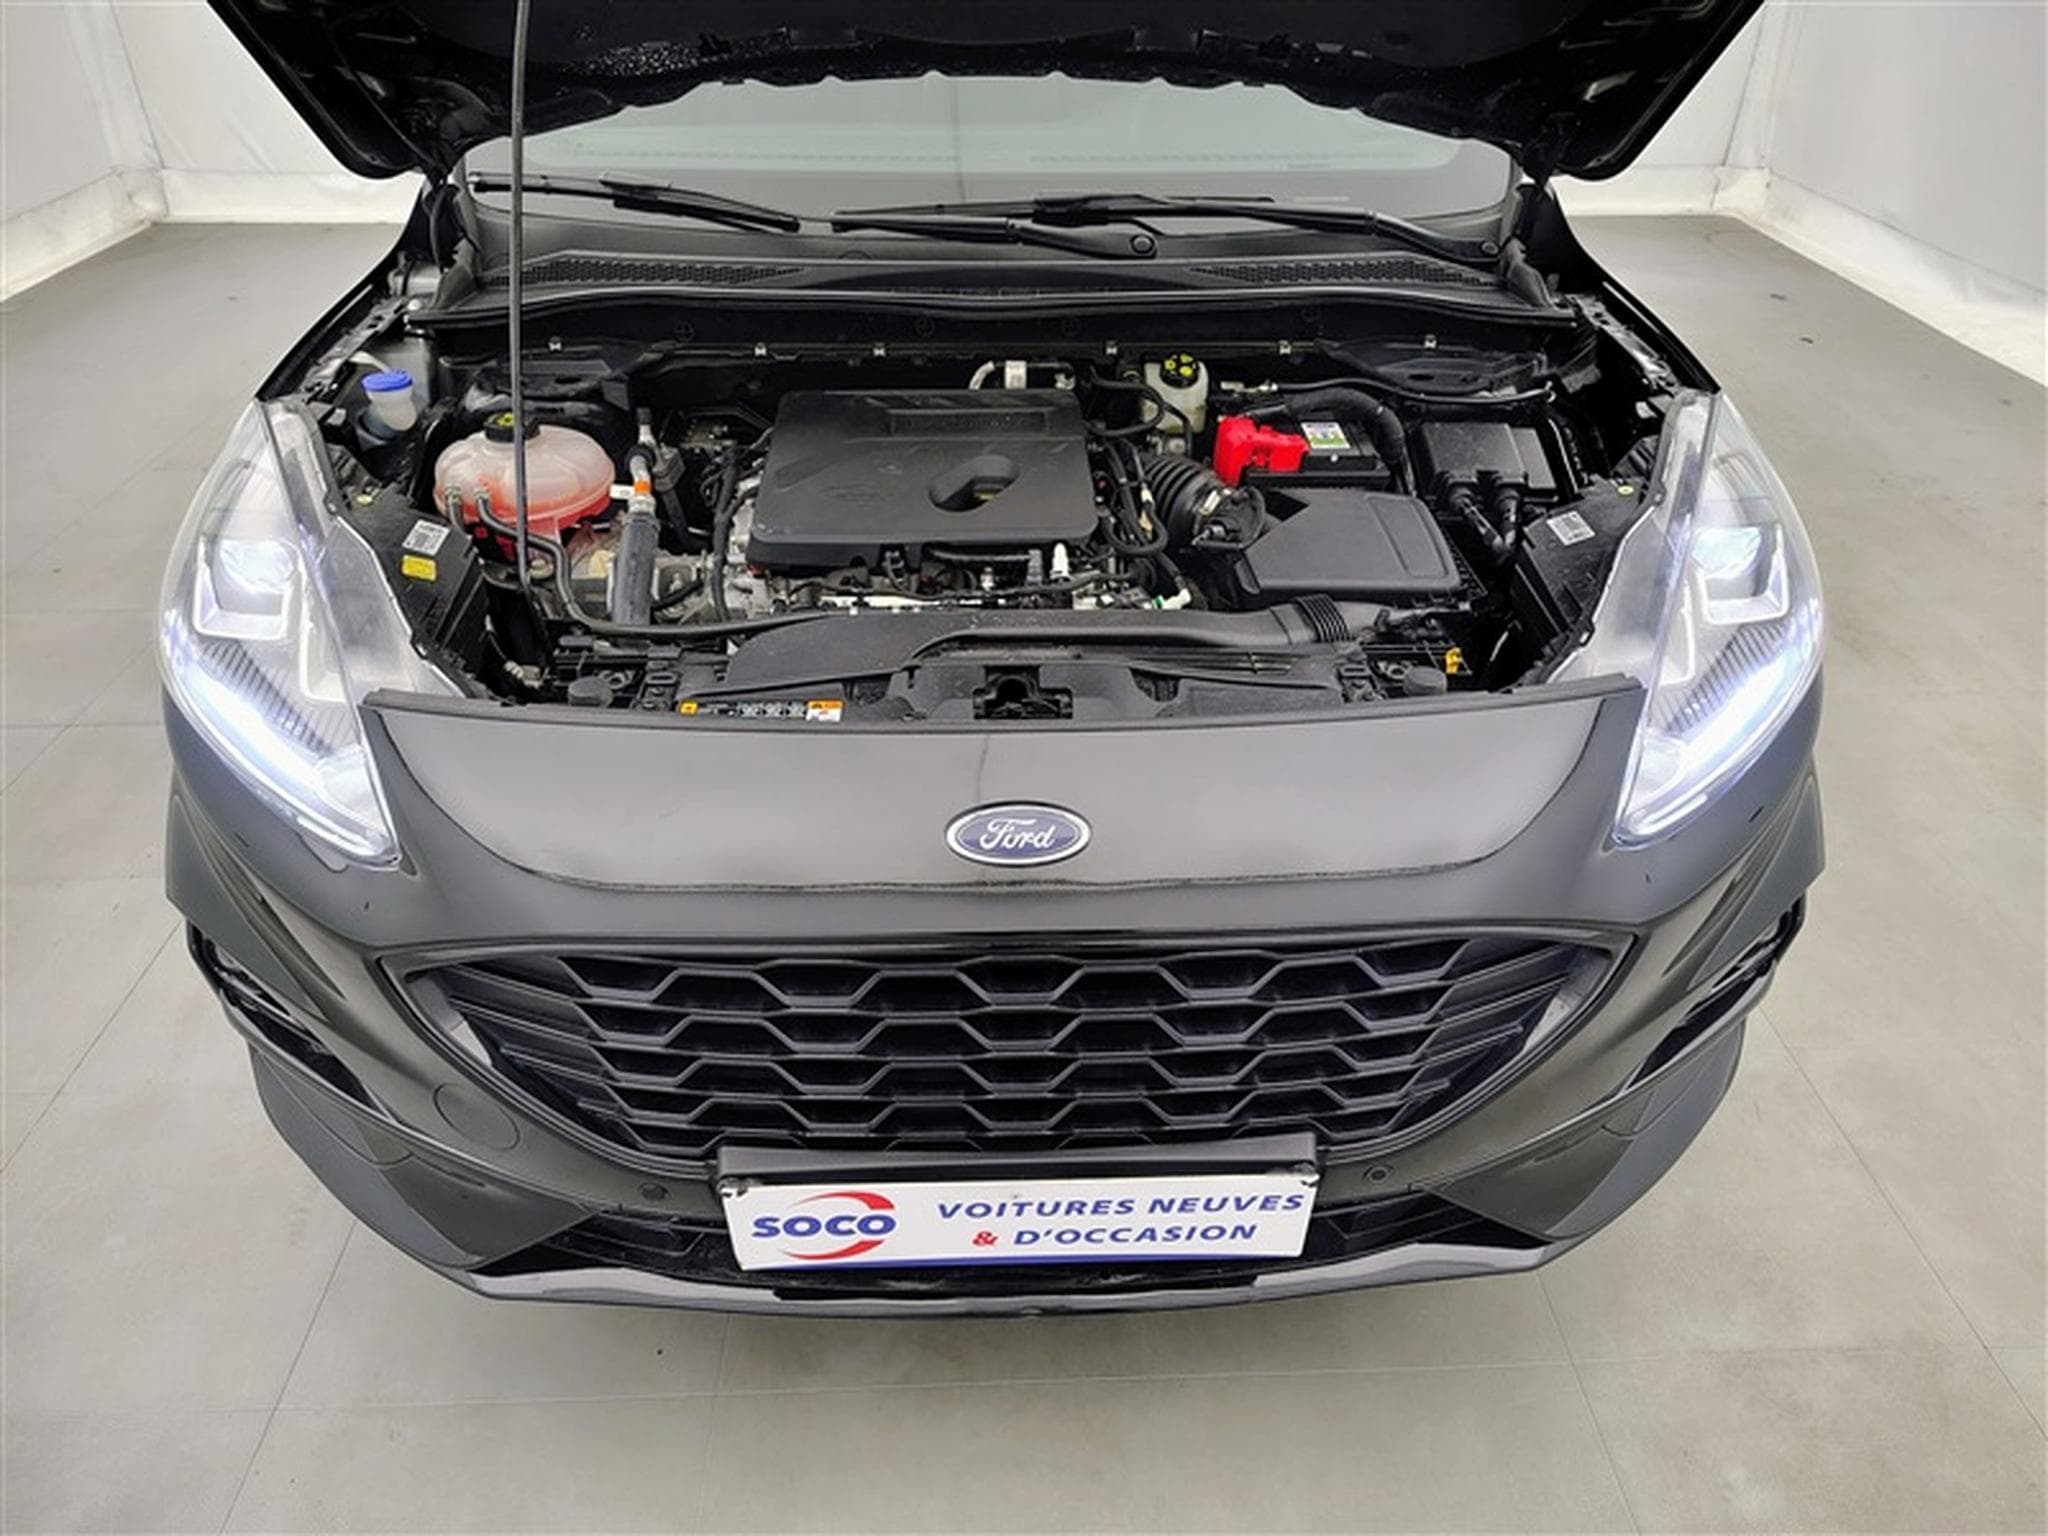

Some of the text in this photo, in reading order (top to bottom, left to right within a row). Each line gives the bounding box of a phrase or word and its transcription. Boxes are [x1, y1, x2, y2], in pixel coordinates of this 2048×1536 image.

[979, 818, 1055, 849] Ford
[938, 1194, 1306, 1219] VOITURES NEUVES
[751, 1213, 896, 1238] SOCO
[972, 1223, 1258, 1246] & D'OCCASION
